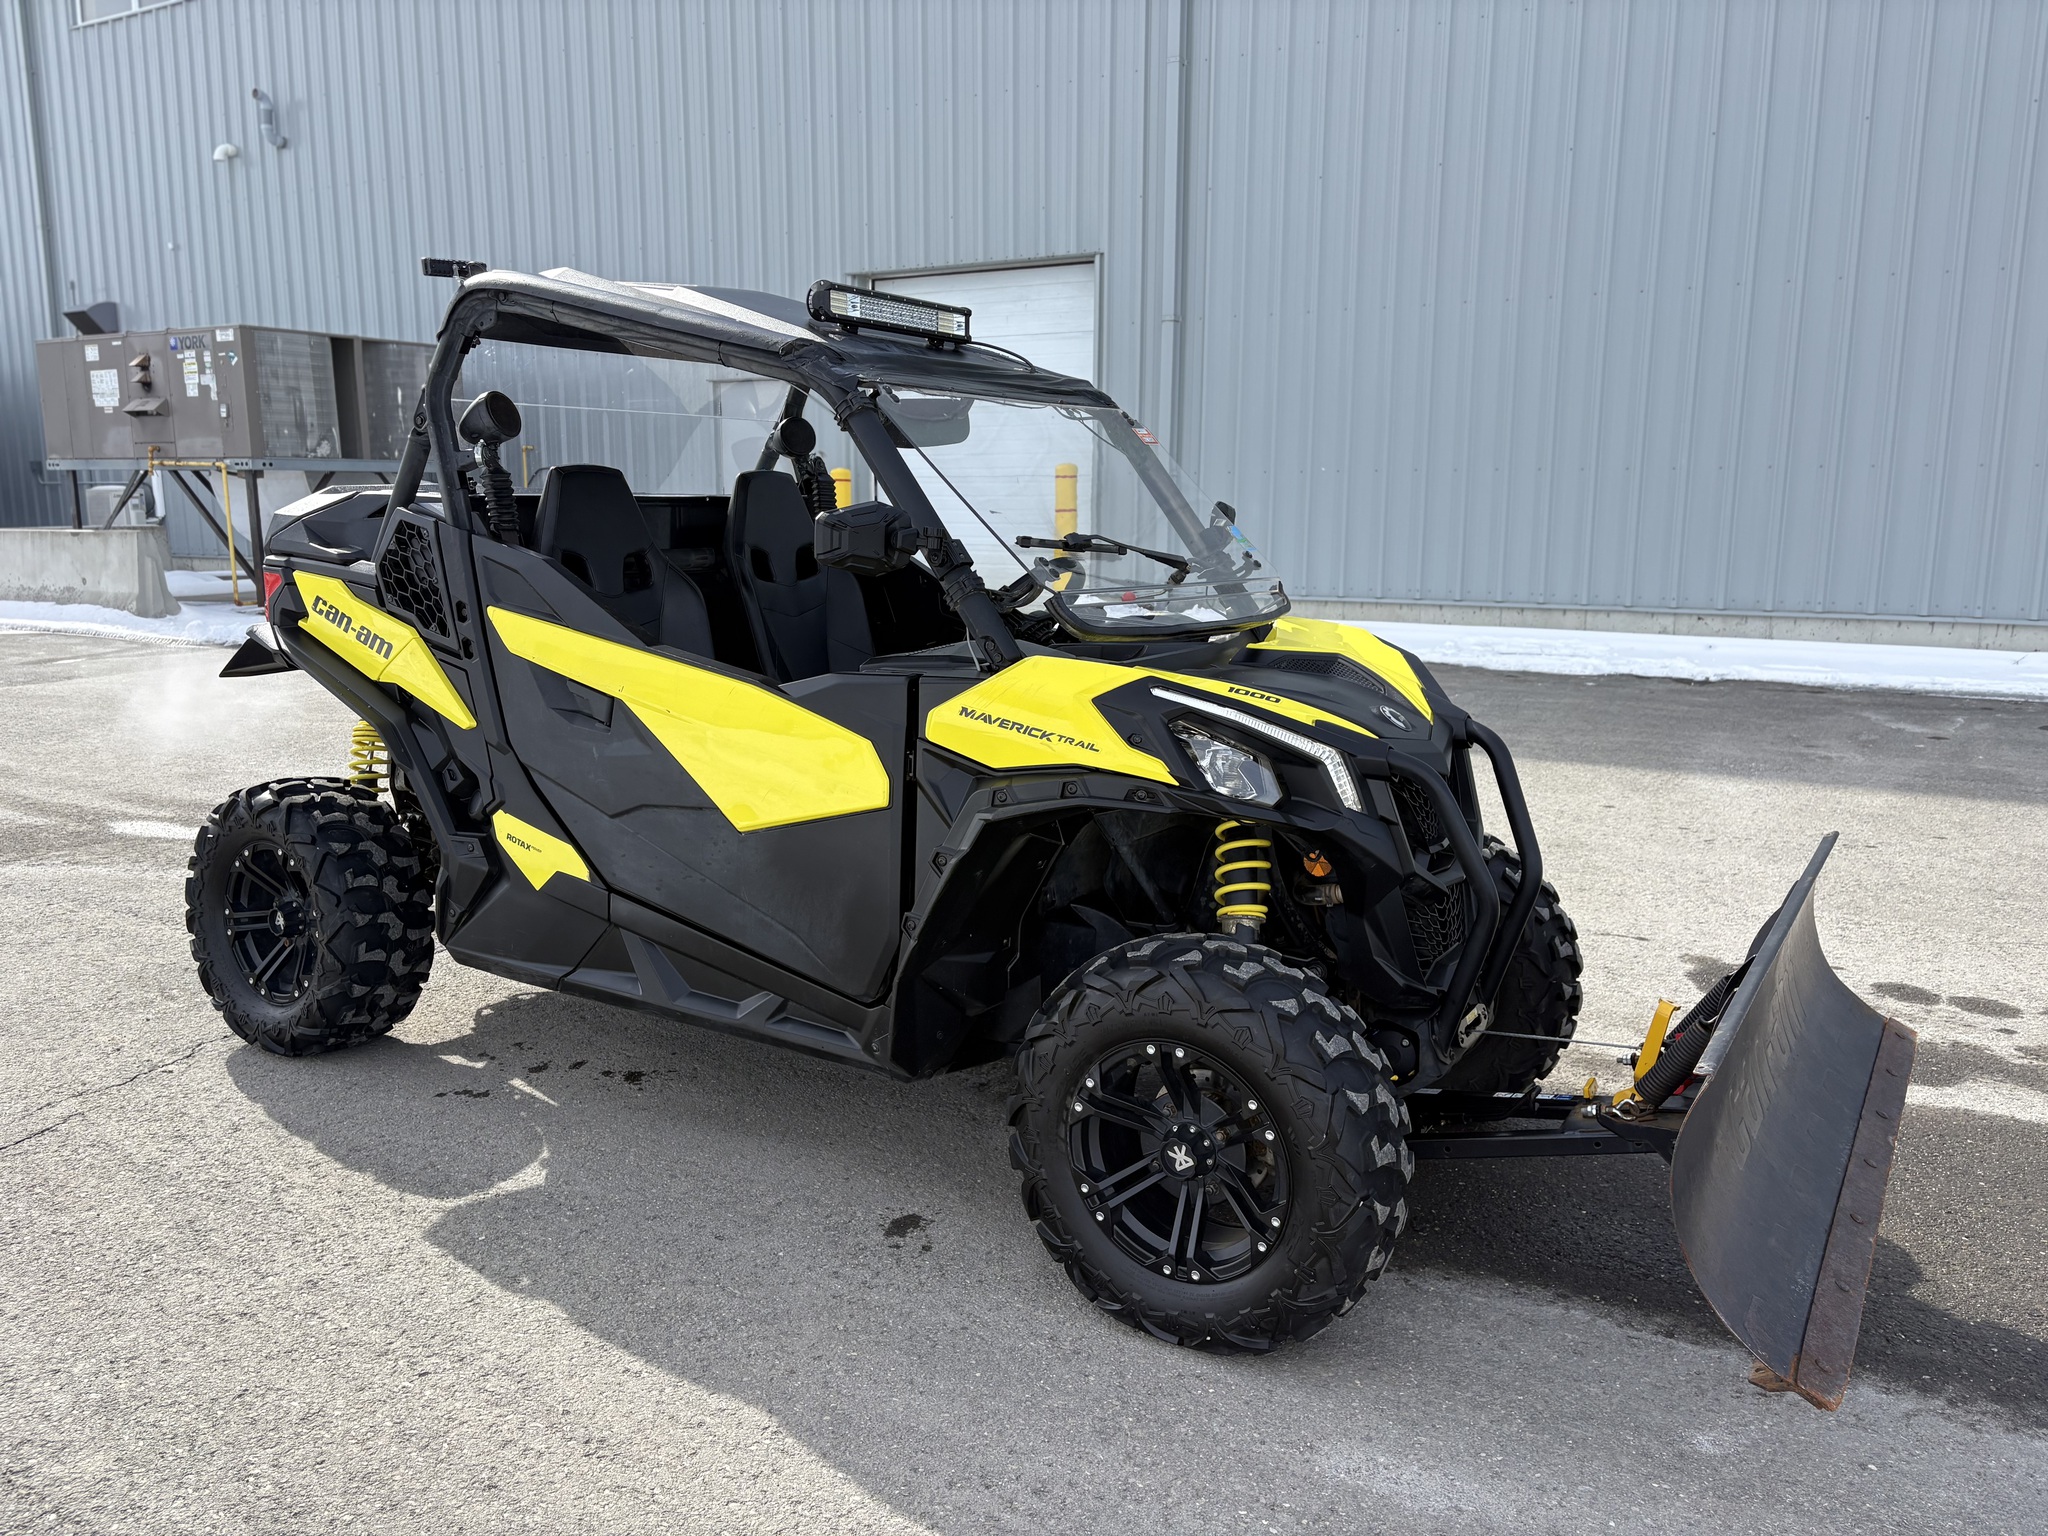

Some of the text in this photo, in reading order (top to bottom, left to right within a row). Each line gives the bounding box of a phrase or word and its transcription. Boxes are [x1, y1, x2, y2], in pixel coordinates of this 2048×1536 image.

[178, 334, 206, 350] YORK
[311, 595, 394, 660] can-am
[1228, 686, 1281, 703] 1000
[959, 706, 1100, 752] MAVERICK TRAIL
[506, 833, 531, 851] ROTAX
